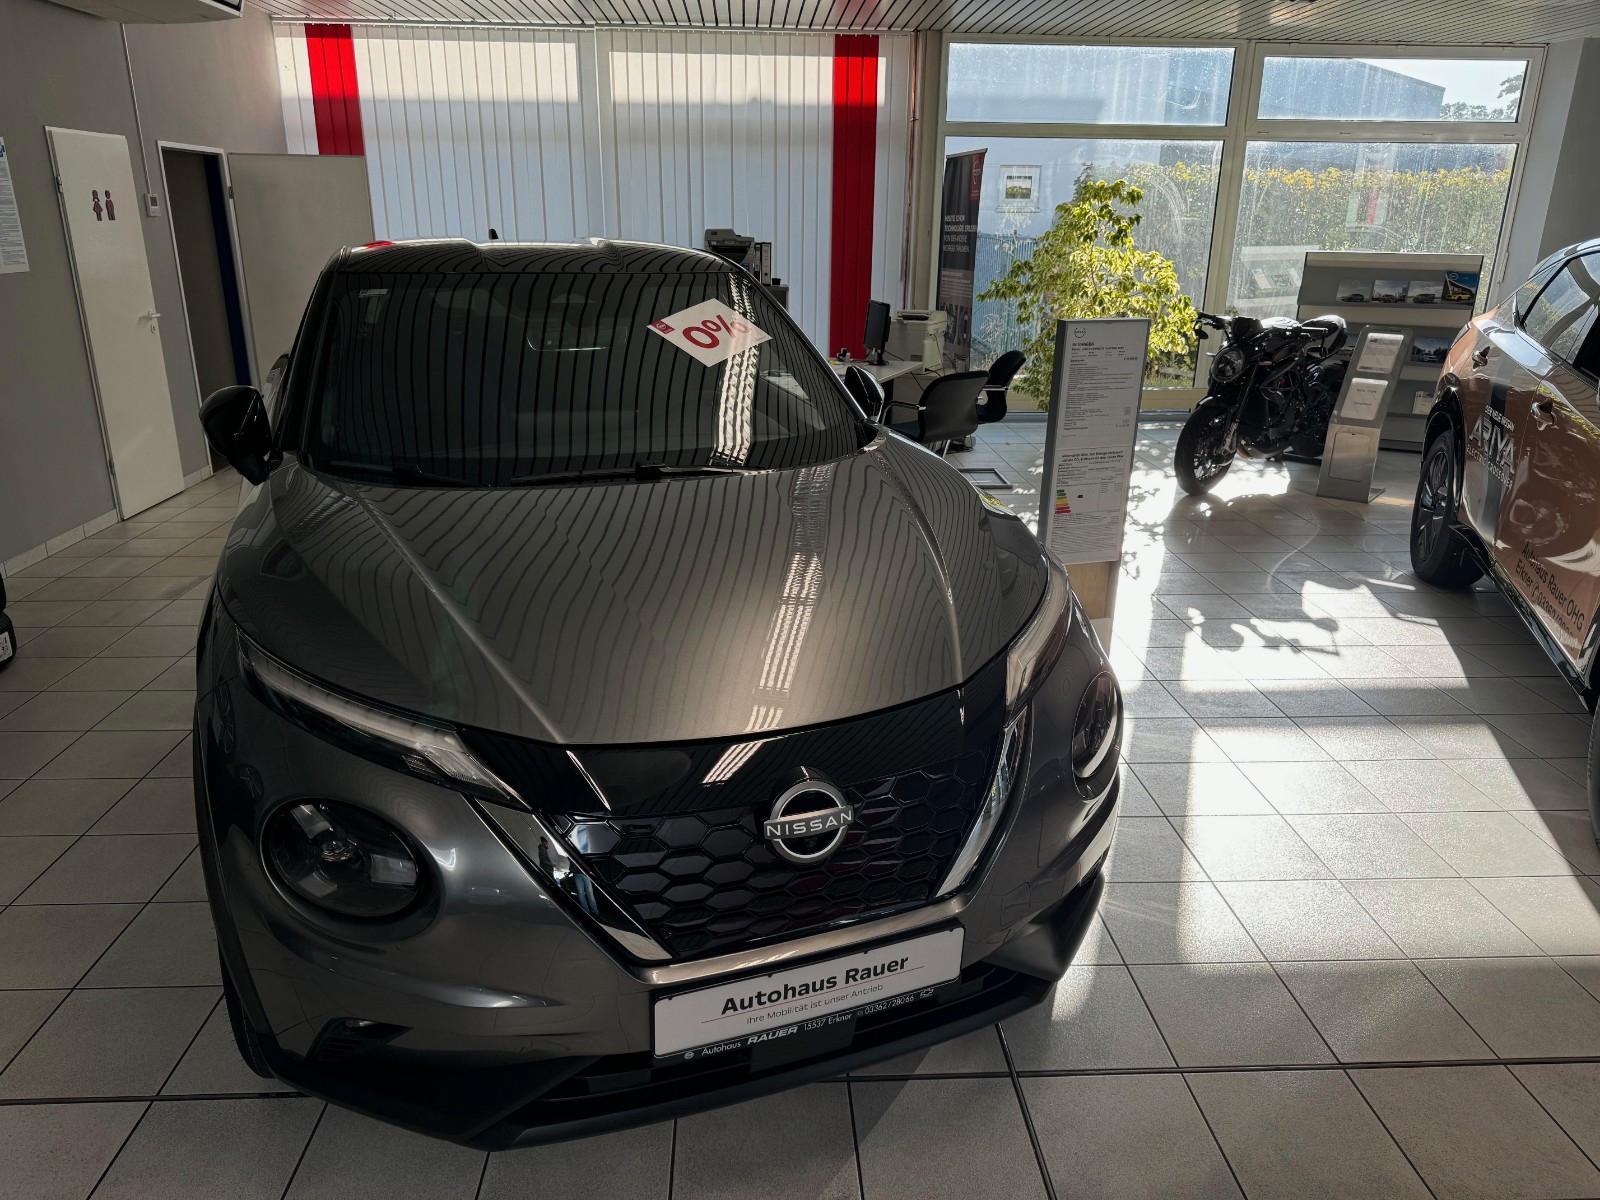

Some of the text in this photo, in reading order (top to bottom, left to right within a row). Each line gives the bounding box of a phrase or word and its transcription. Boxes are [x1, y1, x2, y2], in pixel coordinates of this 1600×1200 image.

[682, 314, 751, 349] 0%
[1469, 416, 1515, 474] ARIYA
[1547, 571, 1569, 607] Rauer
[1566, 599, 1585, 631] OHG
[766, 810, 852, 836] NISSAN
[721, 957, 908, 1015] Autohaus Rauer
[746, 984, 884, 1025] Ihre Mobilität ist unser Antrieb
[701, 1041, 741, 1056] Autohaus
[747, 1026, 798, 1045] RAUER
[804, 1019, 826, 1031] 15537
[828, 1013, 852, 1025] Erkner
